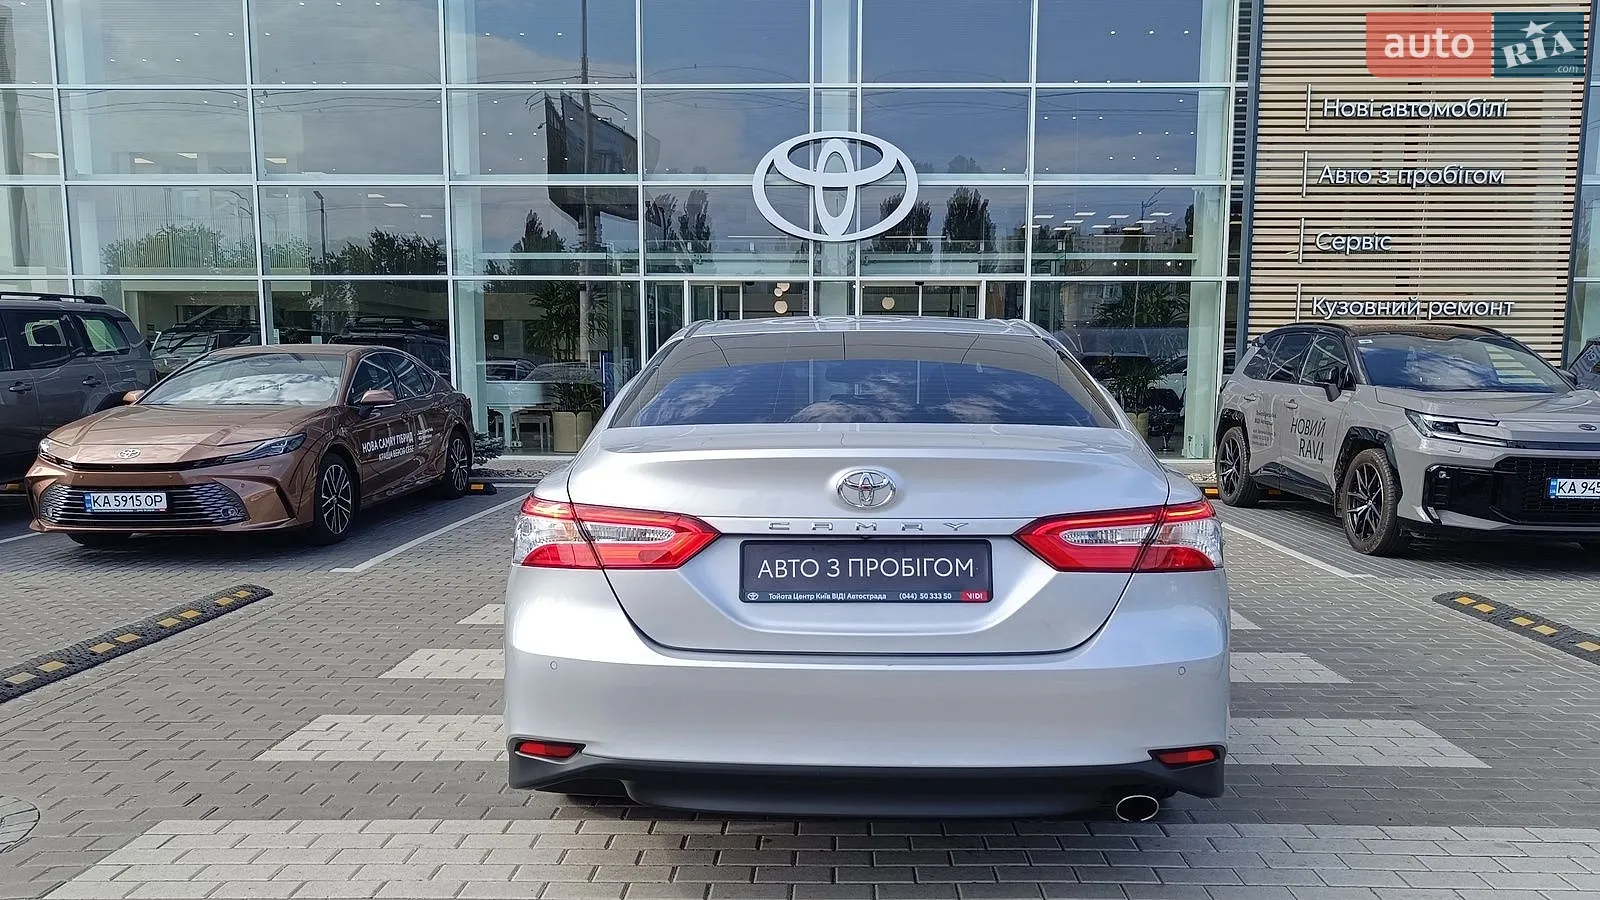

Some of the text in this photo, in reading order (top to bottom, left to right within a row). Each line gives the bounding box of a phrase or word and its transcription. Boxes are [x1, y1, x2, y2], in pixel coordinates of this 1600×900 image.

[1322, 98, 1509, 118] Нові автомобілі
[1317, 164, 1505, 188] Авто з пробігом
[1314, 232, 1392, 254] Сервіс
[1311, 297, 1515, 319] Кузовний ремонт
[1290, 417, 1327, 438] НОВИЙ
[1299, 438, 1324, 463] RAV4
[1557, 481, 1577, 494] KA
[92, 495, 112, 508] KA
[113, 495, 142, 507] 5915
[144, 495, 163, 507] OP
[768, 521, 970, 532] CAMRY
[757, 558, 820, 579] АВТО
[848, 557, 975, 579] ПРОБІГОМ
[815, 592, 831, 600] Київ
[899, 592, 918, 600] (044)
